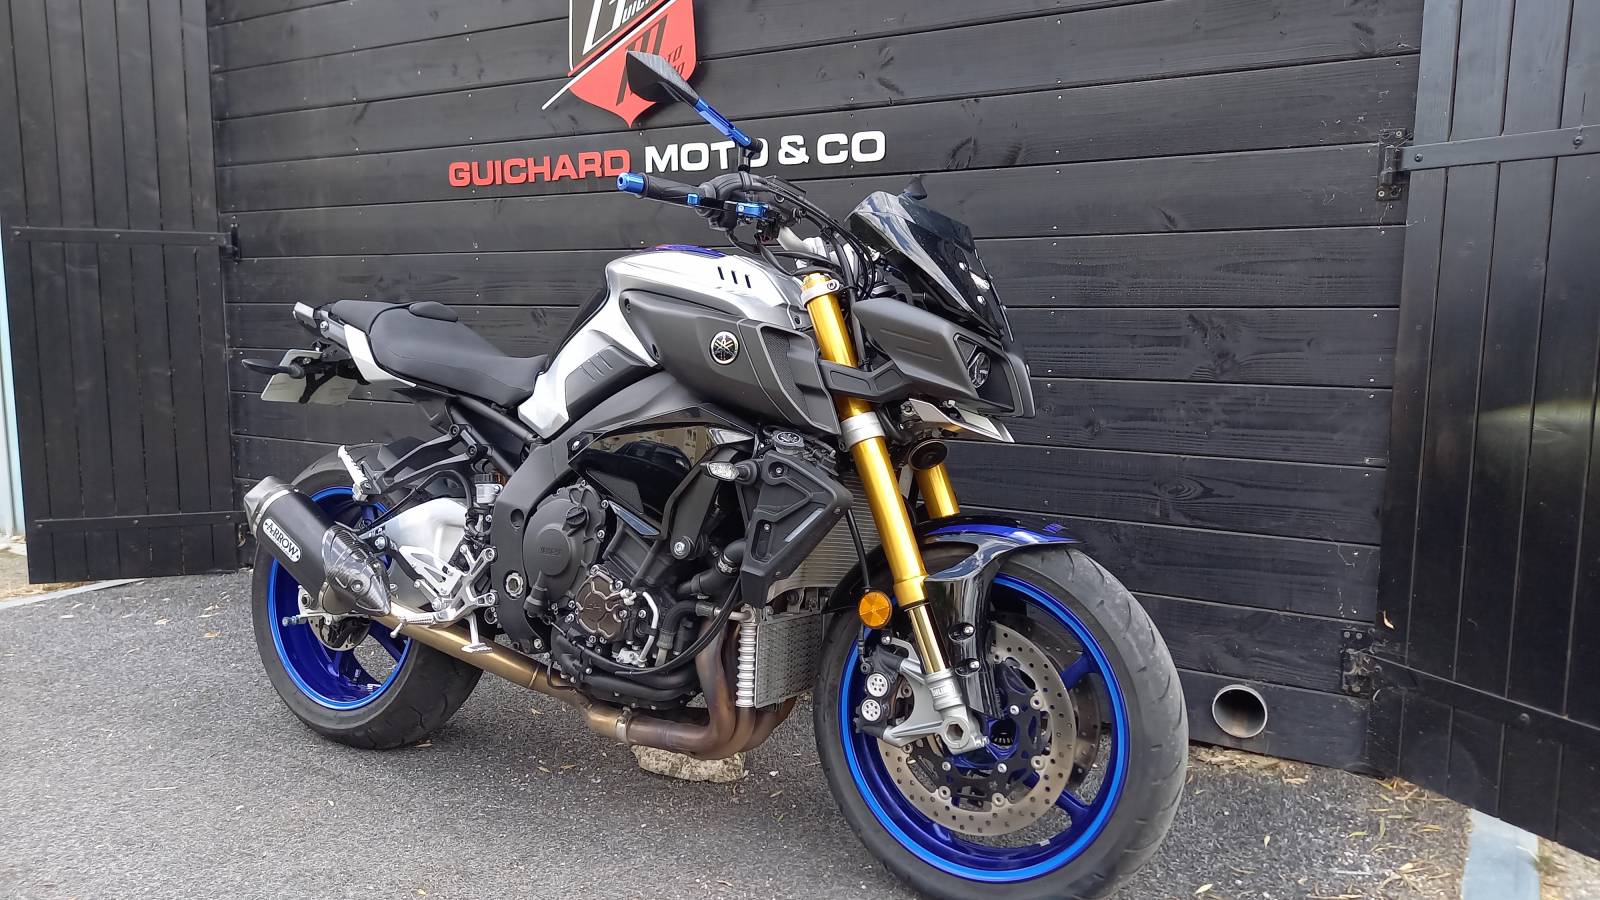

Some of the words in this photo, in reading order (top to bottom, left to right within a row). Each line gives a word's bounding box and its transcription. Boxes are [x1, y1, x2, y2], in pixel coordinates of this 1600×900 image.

[449, 149, 631, 187] GUICHARD
[778, 135, 810, 165] &
[816, 130, 886, 164] CO
[265, 522, 298, 556] ARROW
